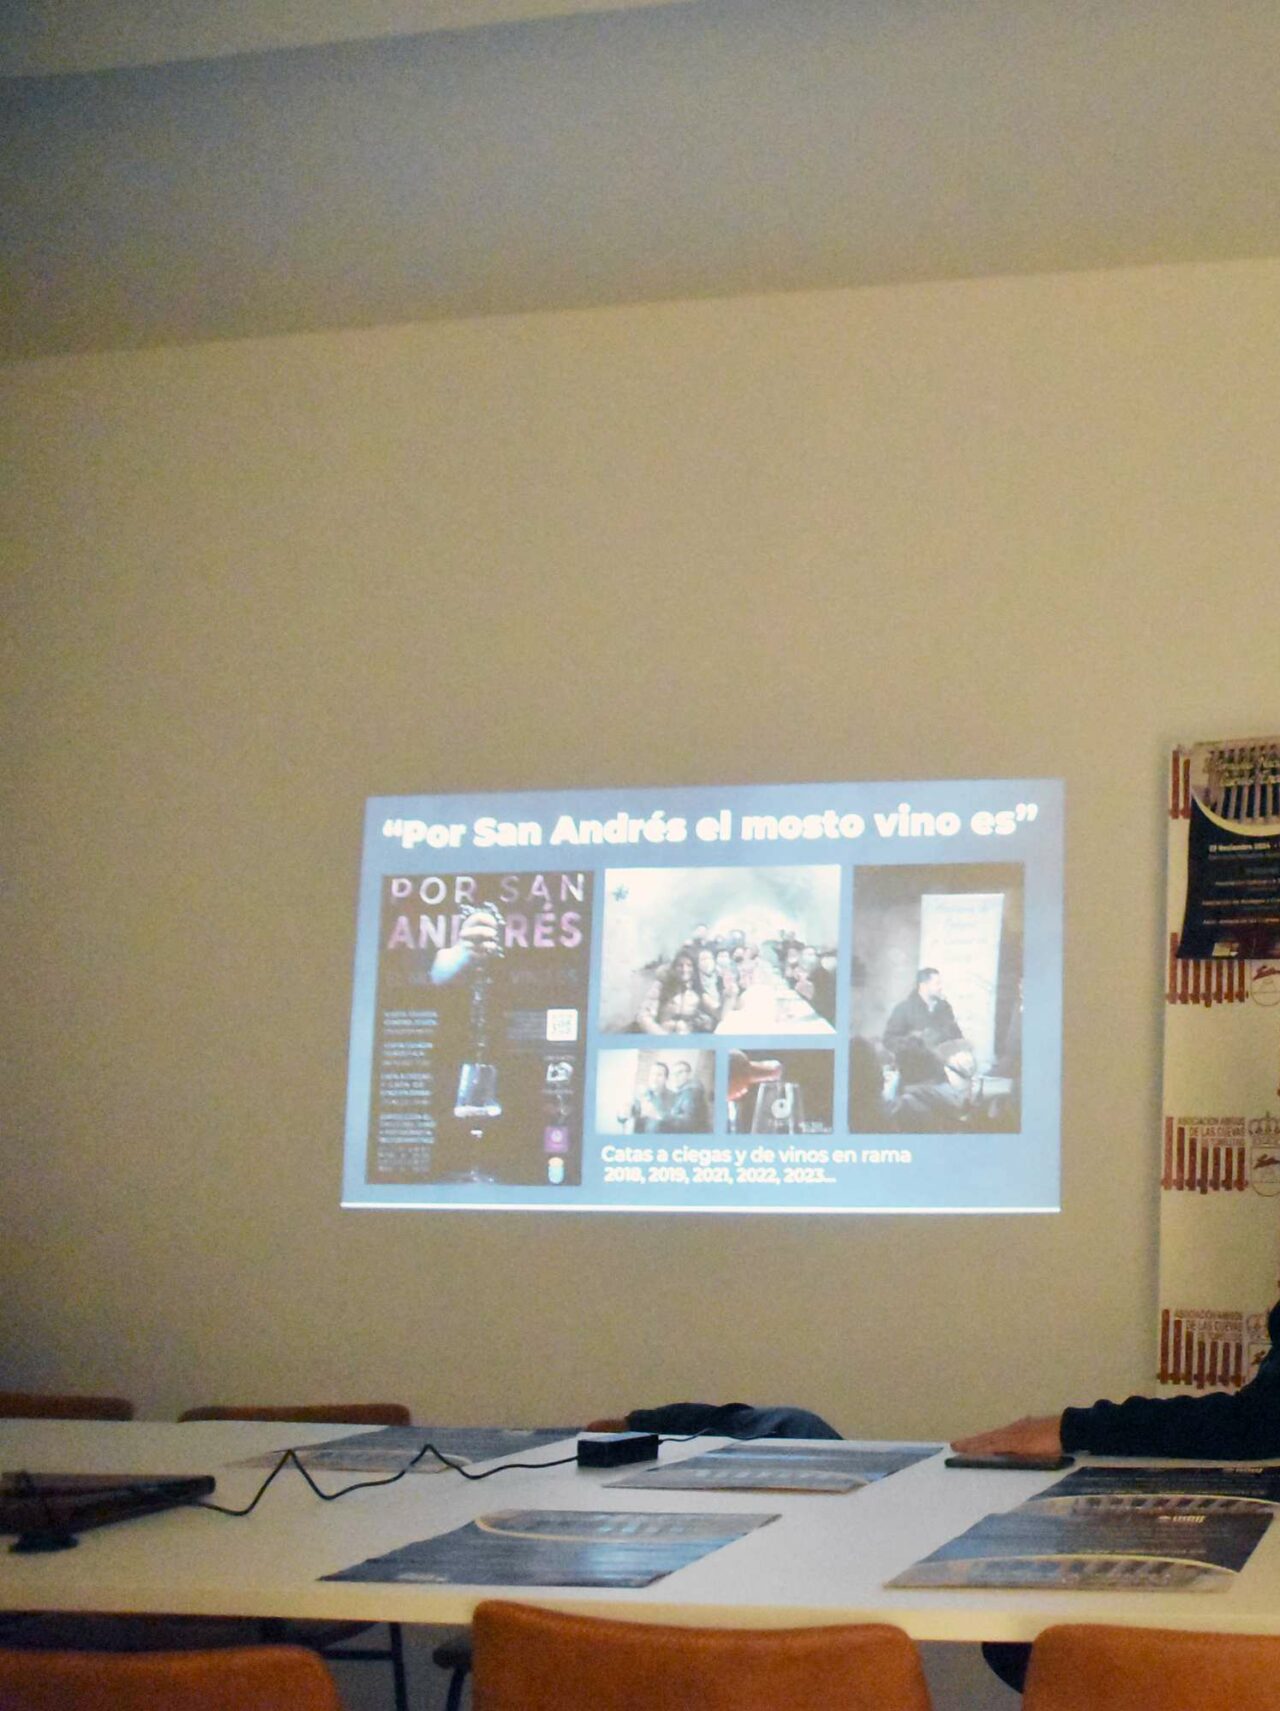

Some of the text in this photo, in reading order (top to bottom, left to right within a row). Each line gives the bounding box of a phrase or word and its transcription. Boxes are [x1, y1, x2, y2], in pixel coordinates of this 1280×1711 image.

[473, 816, 542, 847] San
[550, 810, 688, 846] Andrés
[696, 809, 732, 842] el
[742, 809, 866, 841] mosto
[874, 803, 961, 838] vino
[390, 873, 584, 904] POR SAN
[601, 1145, 912, 1166] Catas a ciegas y de vinos en rama
[604, 1167, 646, 1185] 2018,
[649, 1167, 690, 1185] 2019,
[692, 1167, 733, 1185] 2021,
[736, 1167, 781, 1185] 2022,
